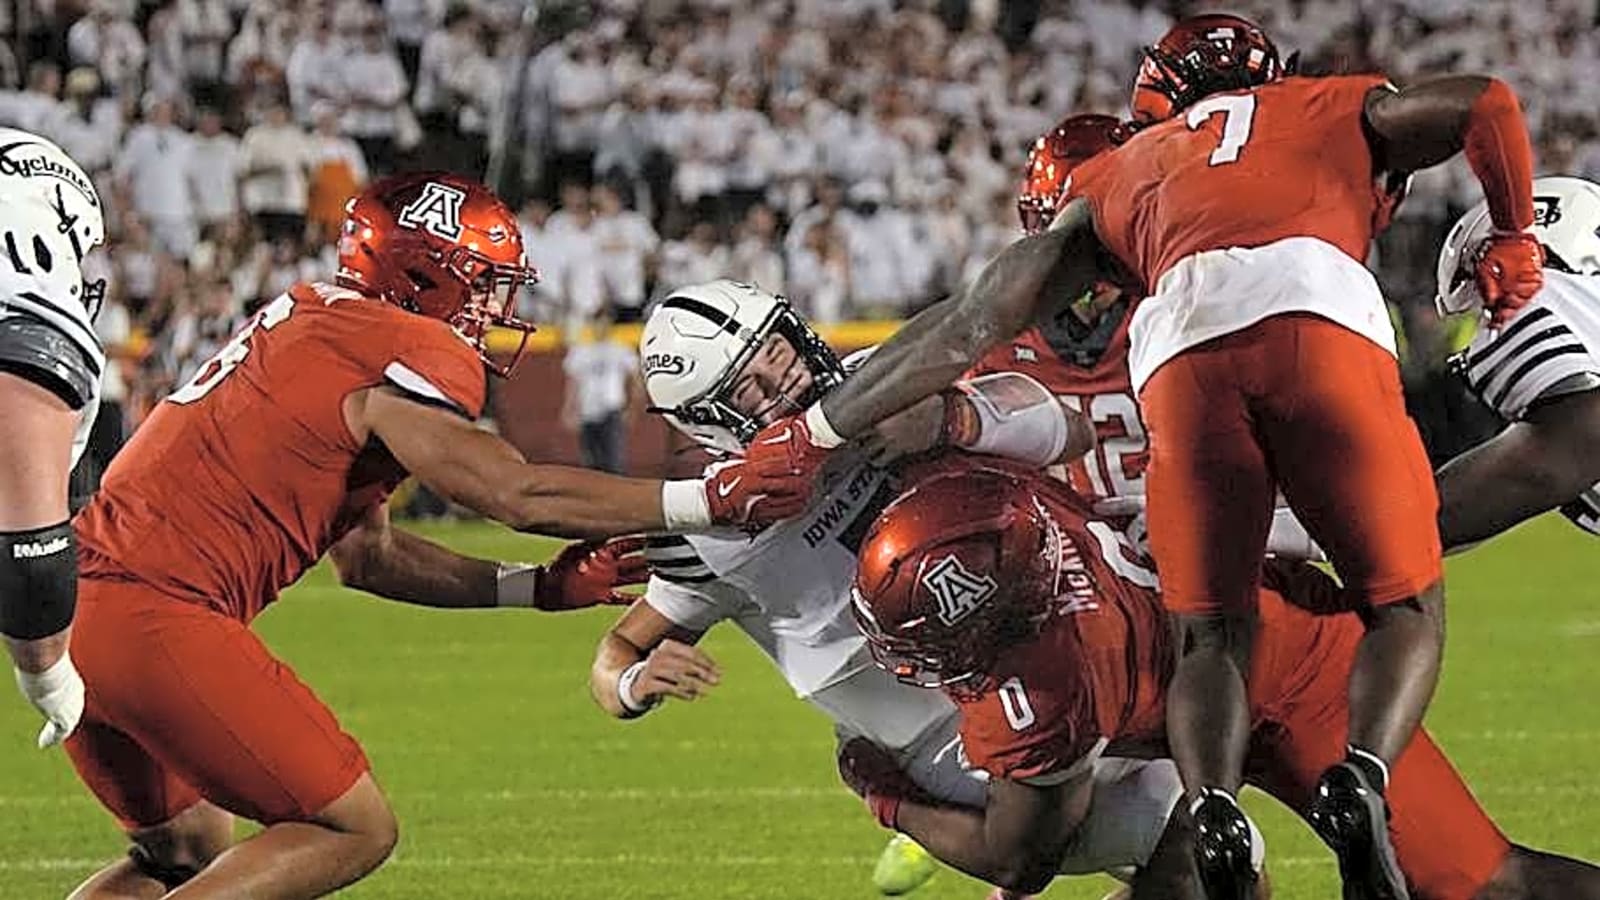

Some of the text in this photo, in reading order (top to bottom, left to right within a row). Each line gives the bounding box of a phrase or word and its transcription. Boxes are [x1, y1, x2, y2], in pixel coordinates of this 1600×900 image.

[1185, 94, 1258, 167] 7
[398, 182, 467, 244] A
[802, 499, 850, 549] IOWA
[922, 554, 999, 627] A
[999, 676, 1035, 731] 0
